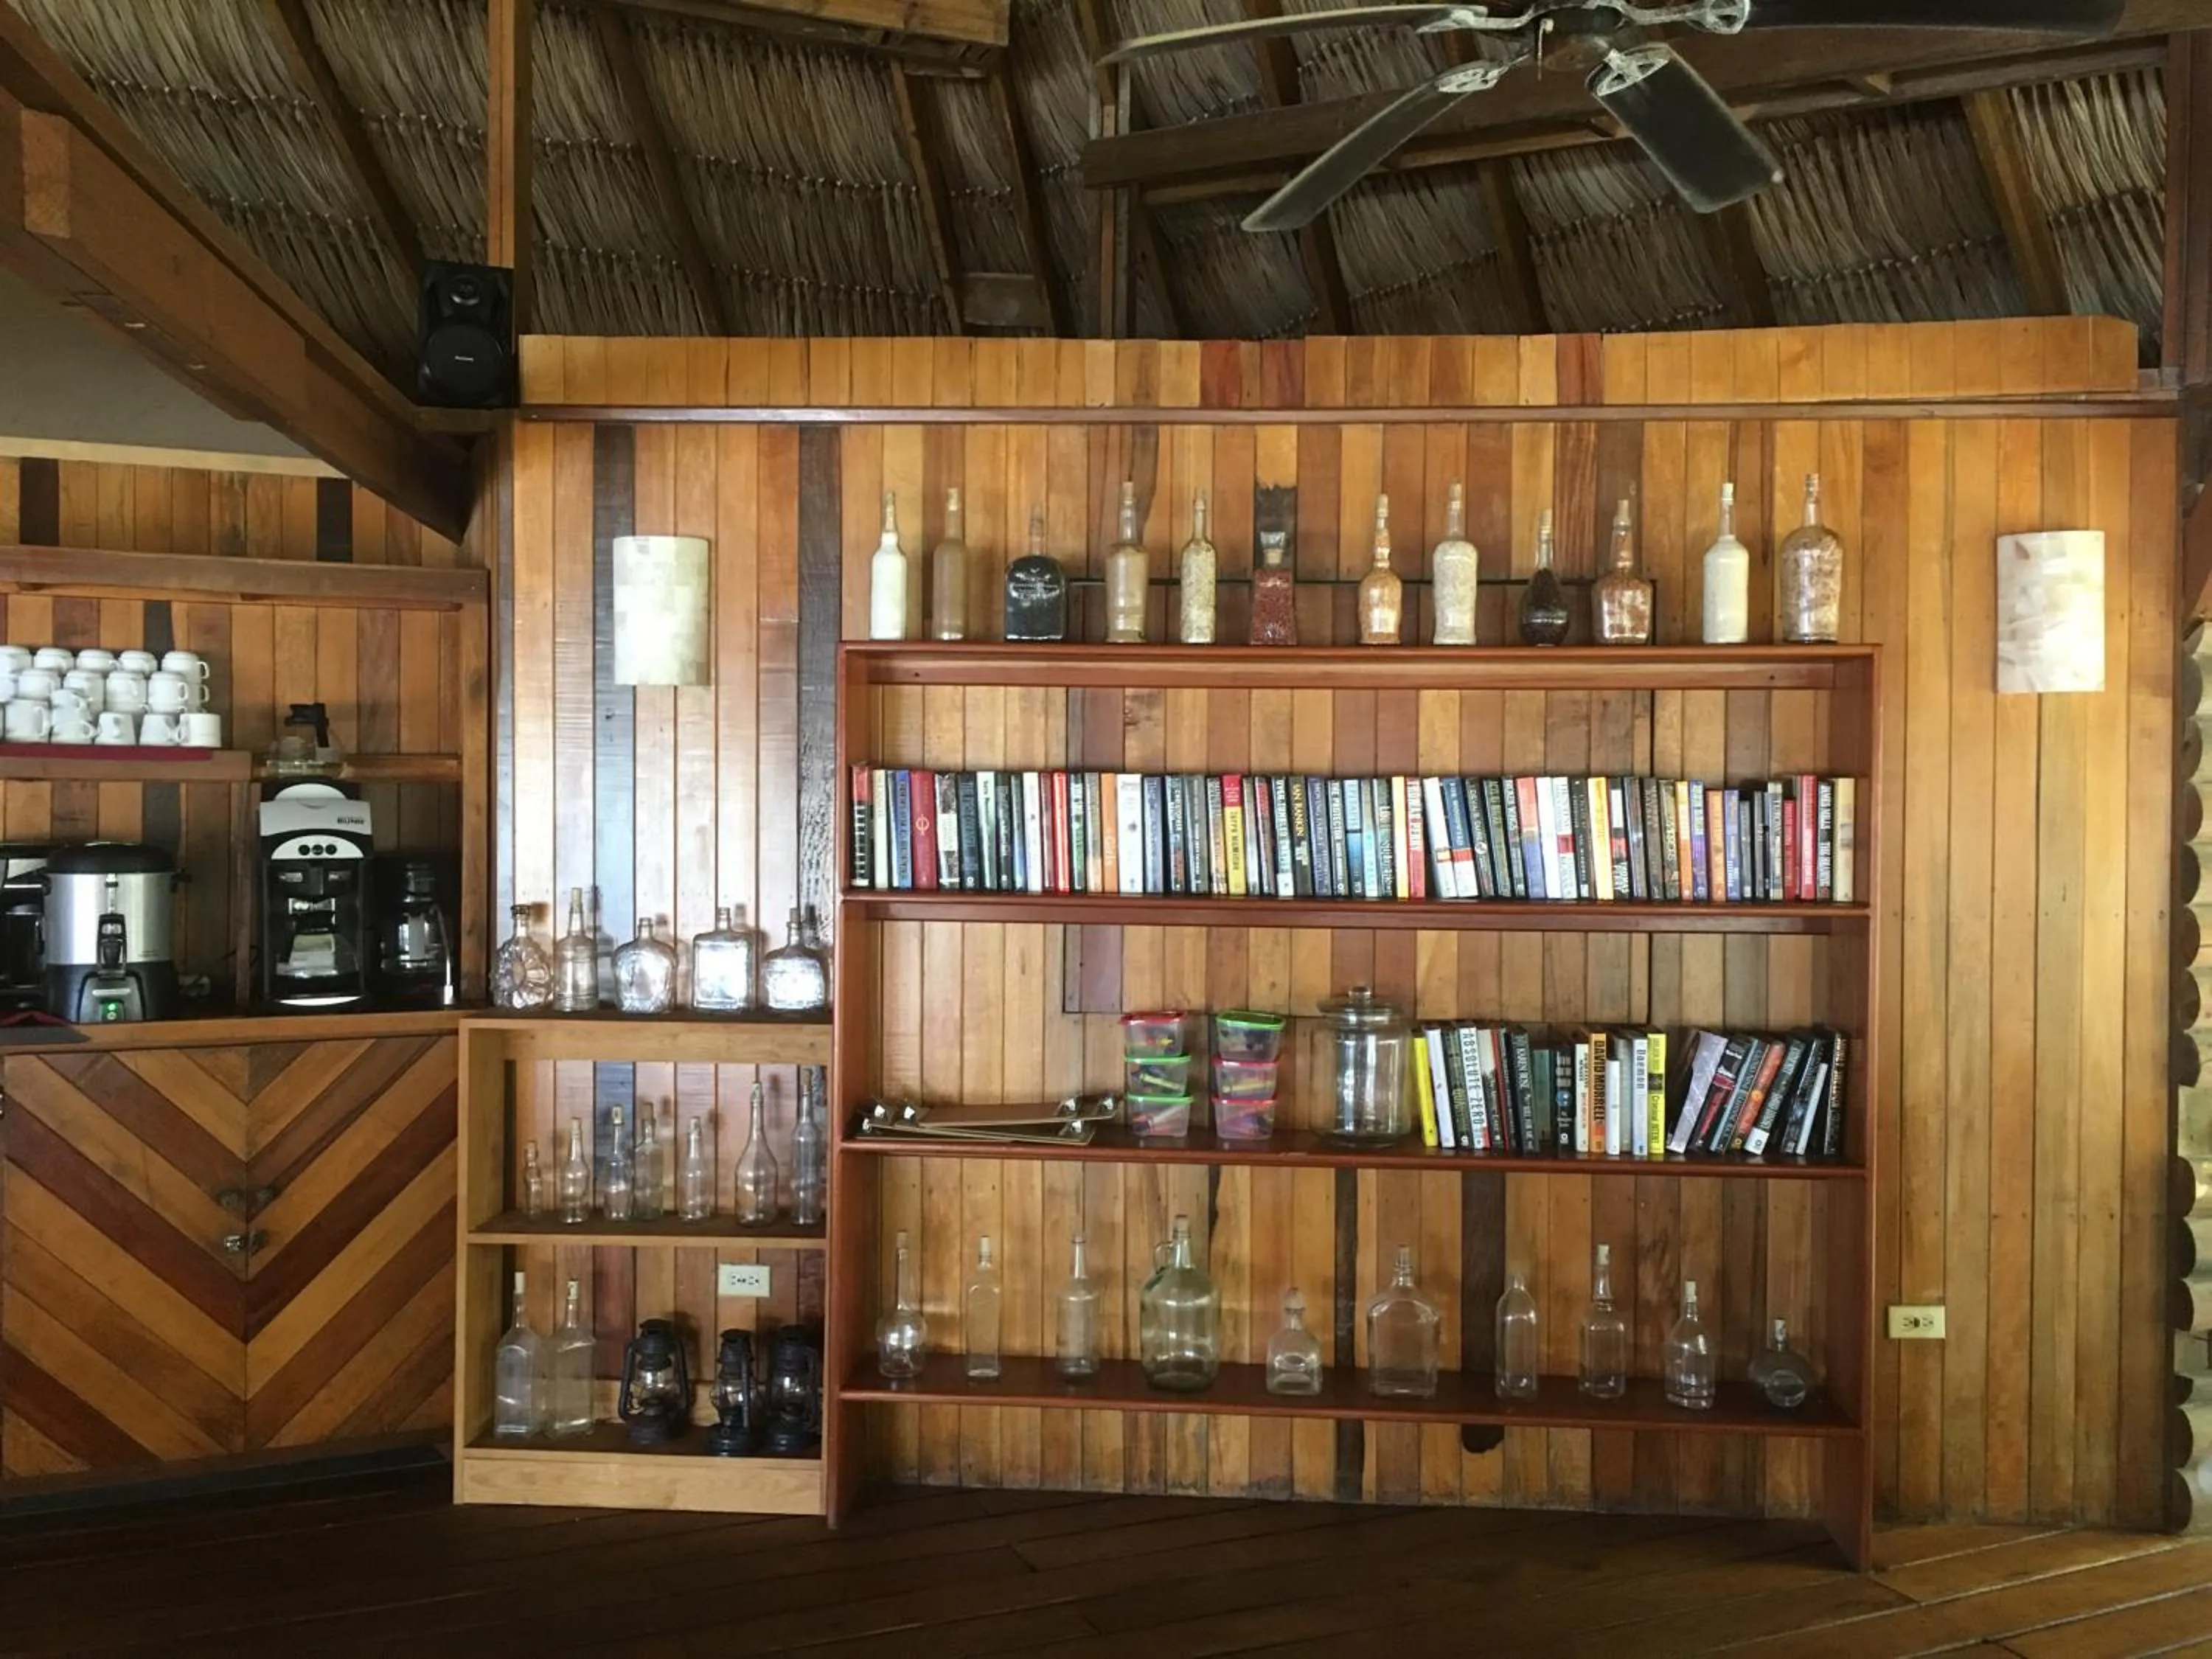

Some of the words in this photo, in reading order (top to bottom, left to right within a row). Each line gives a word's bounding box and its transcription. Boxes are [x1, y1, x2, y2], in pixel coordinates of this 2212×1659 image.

[1292, 783, 1301, 800] IAN
[1331, 782, 1339, 795] THE
[1293, 802, 1304, 836] RANKIN
[1332, 797, 1342, 839] PROTECTOR
[1462, 1032, 1481, 1091] ABSOLUTE
[1594, 1040, 1604, 1072] DAVID
[1636, 1049, 1646, 1088] Daemon
[1470, 1096, 1484, 1124] ZERO
[1594, 1074, 1604, 1120] MORRELL
